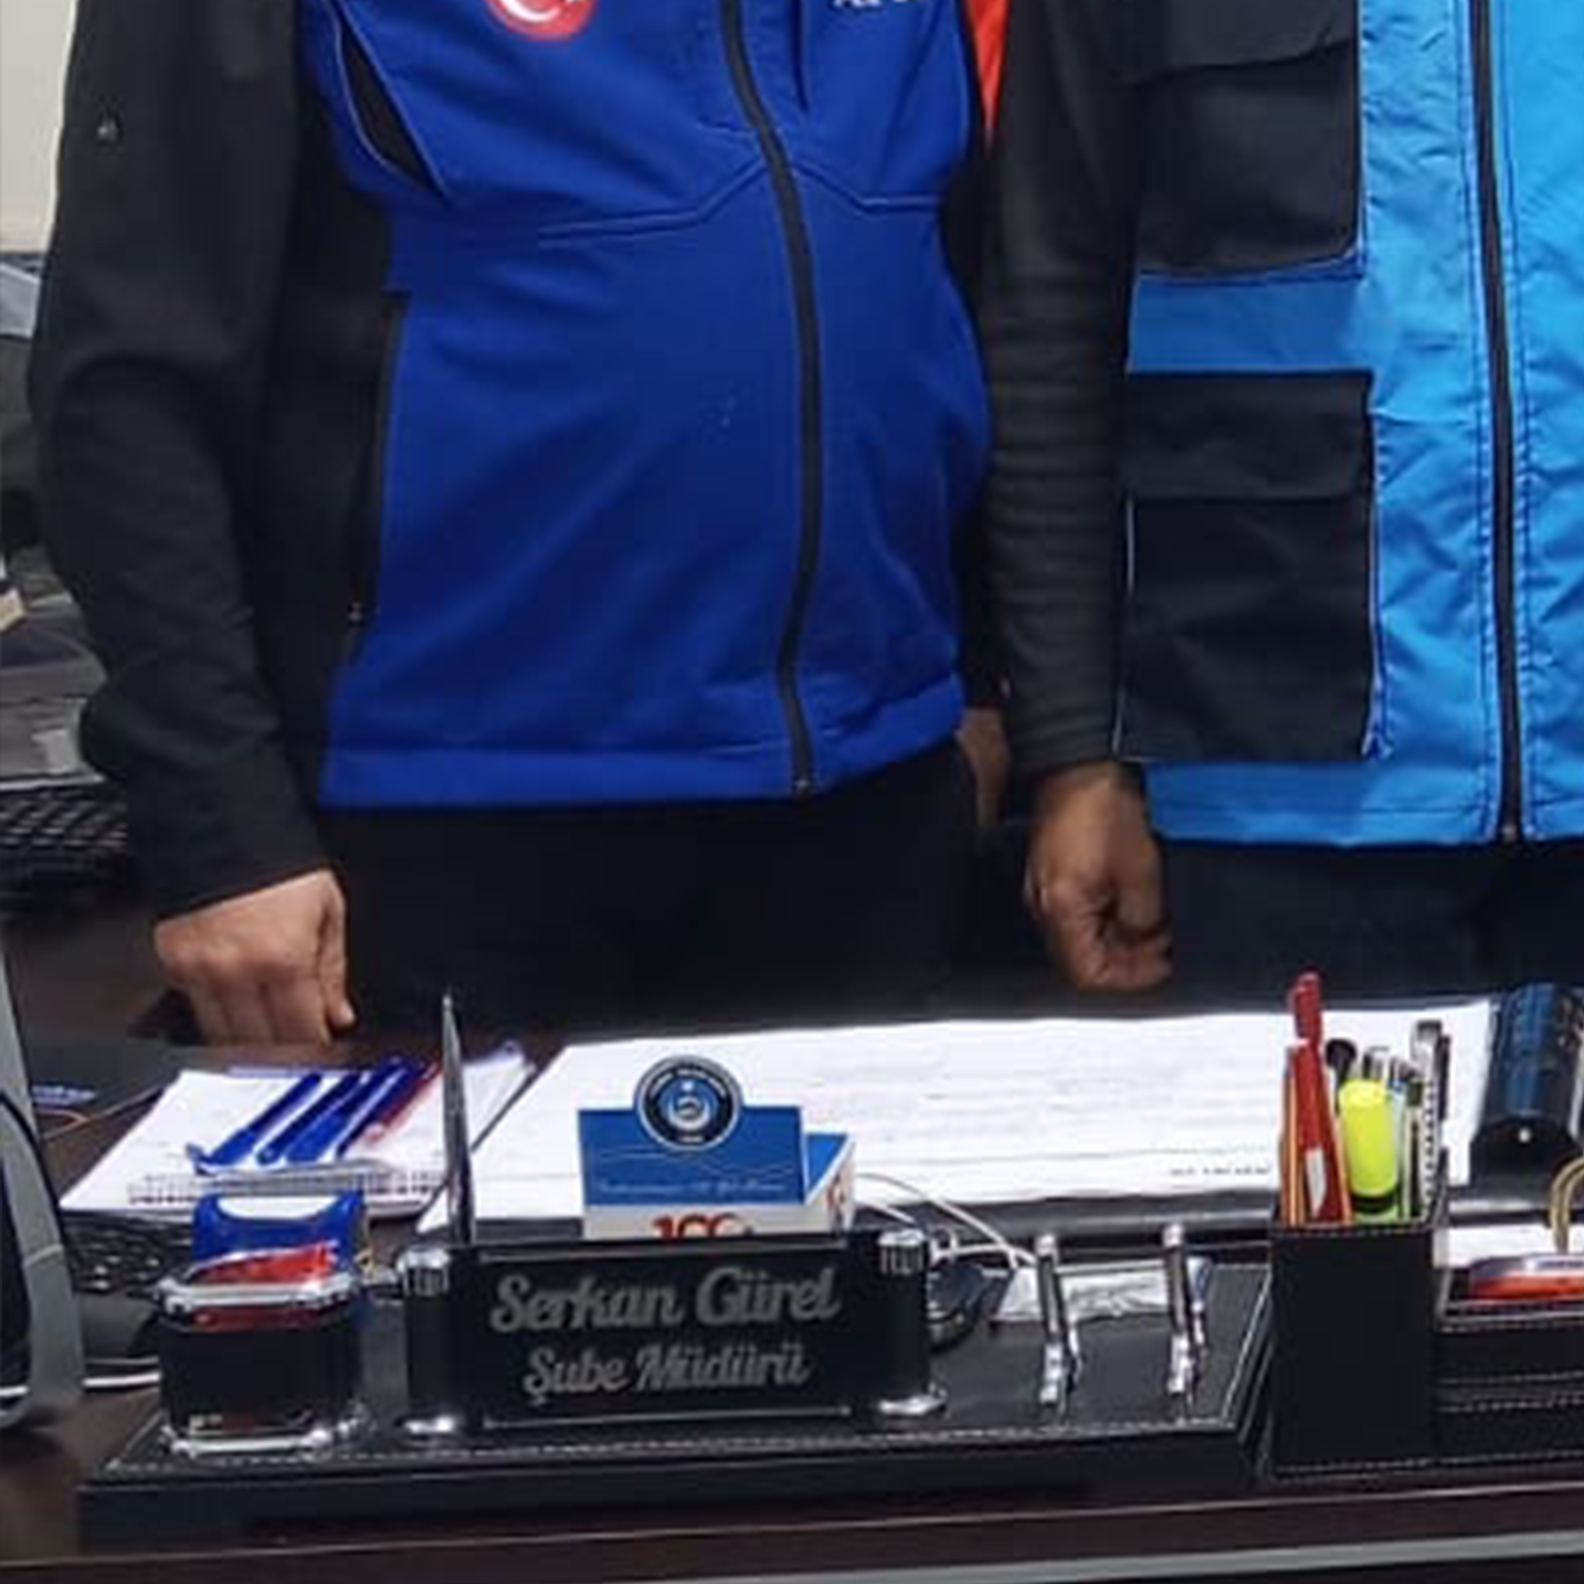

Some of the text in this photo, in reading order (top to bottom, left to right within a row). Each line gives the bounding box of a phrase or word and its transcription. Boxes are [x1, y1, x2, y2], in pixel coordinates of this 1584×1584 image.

[491, 1265, 842, 1332] Serkan Gürel
[522, 1342, 813, 1408] Şube Müdürü
